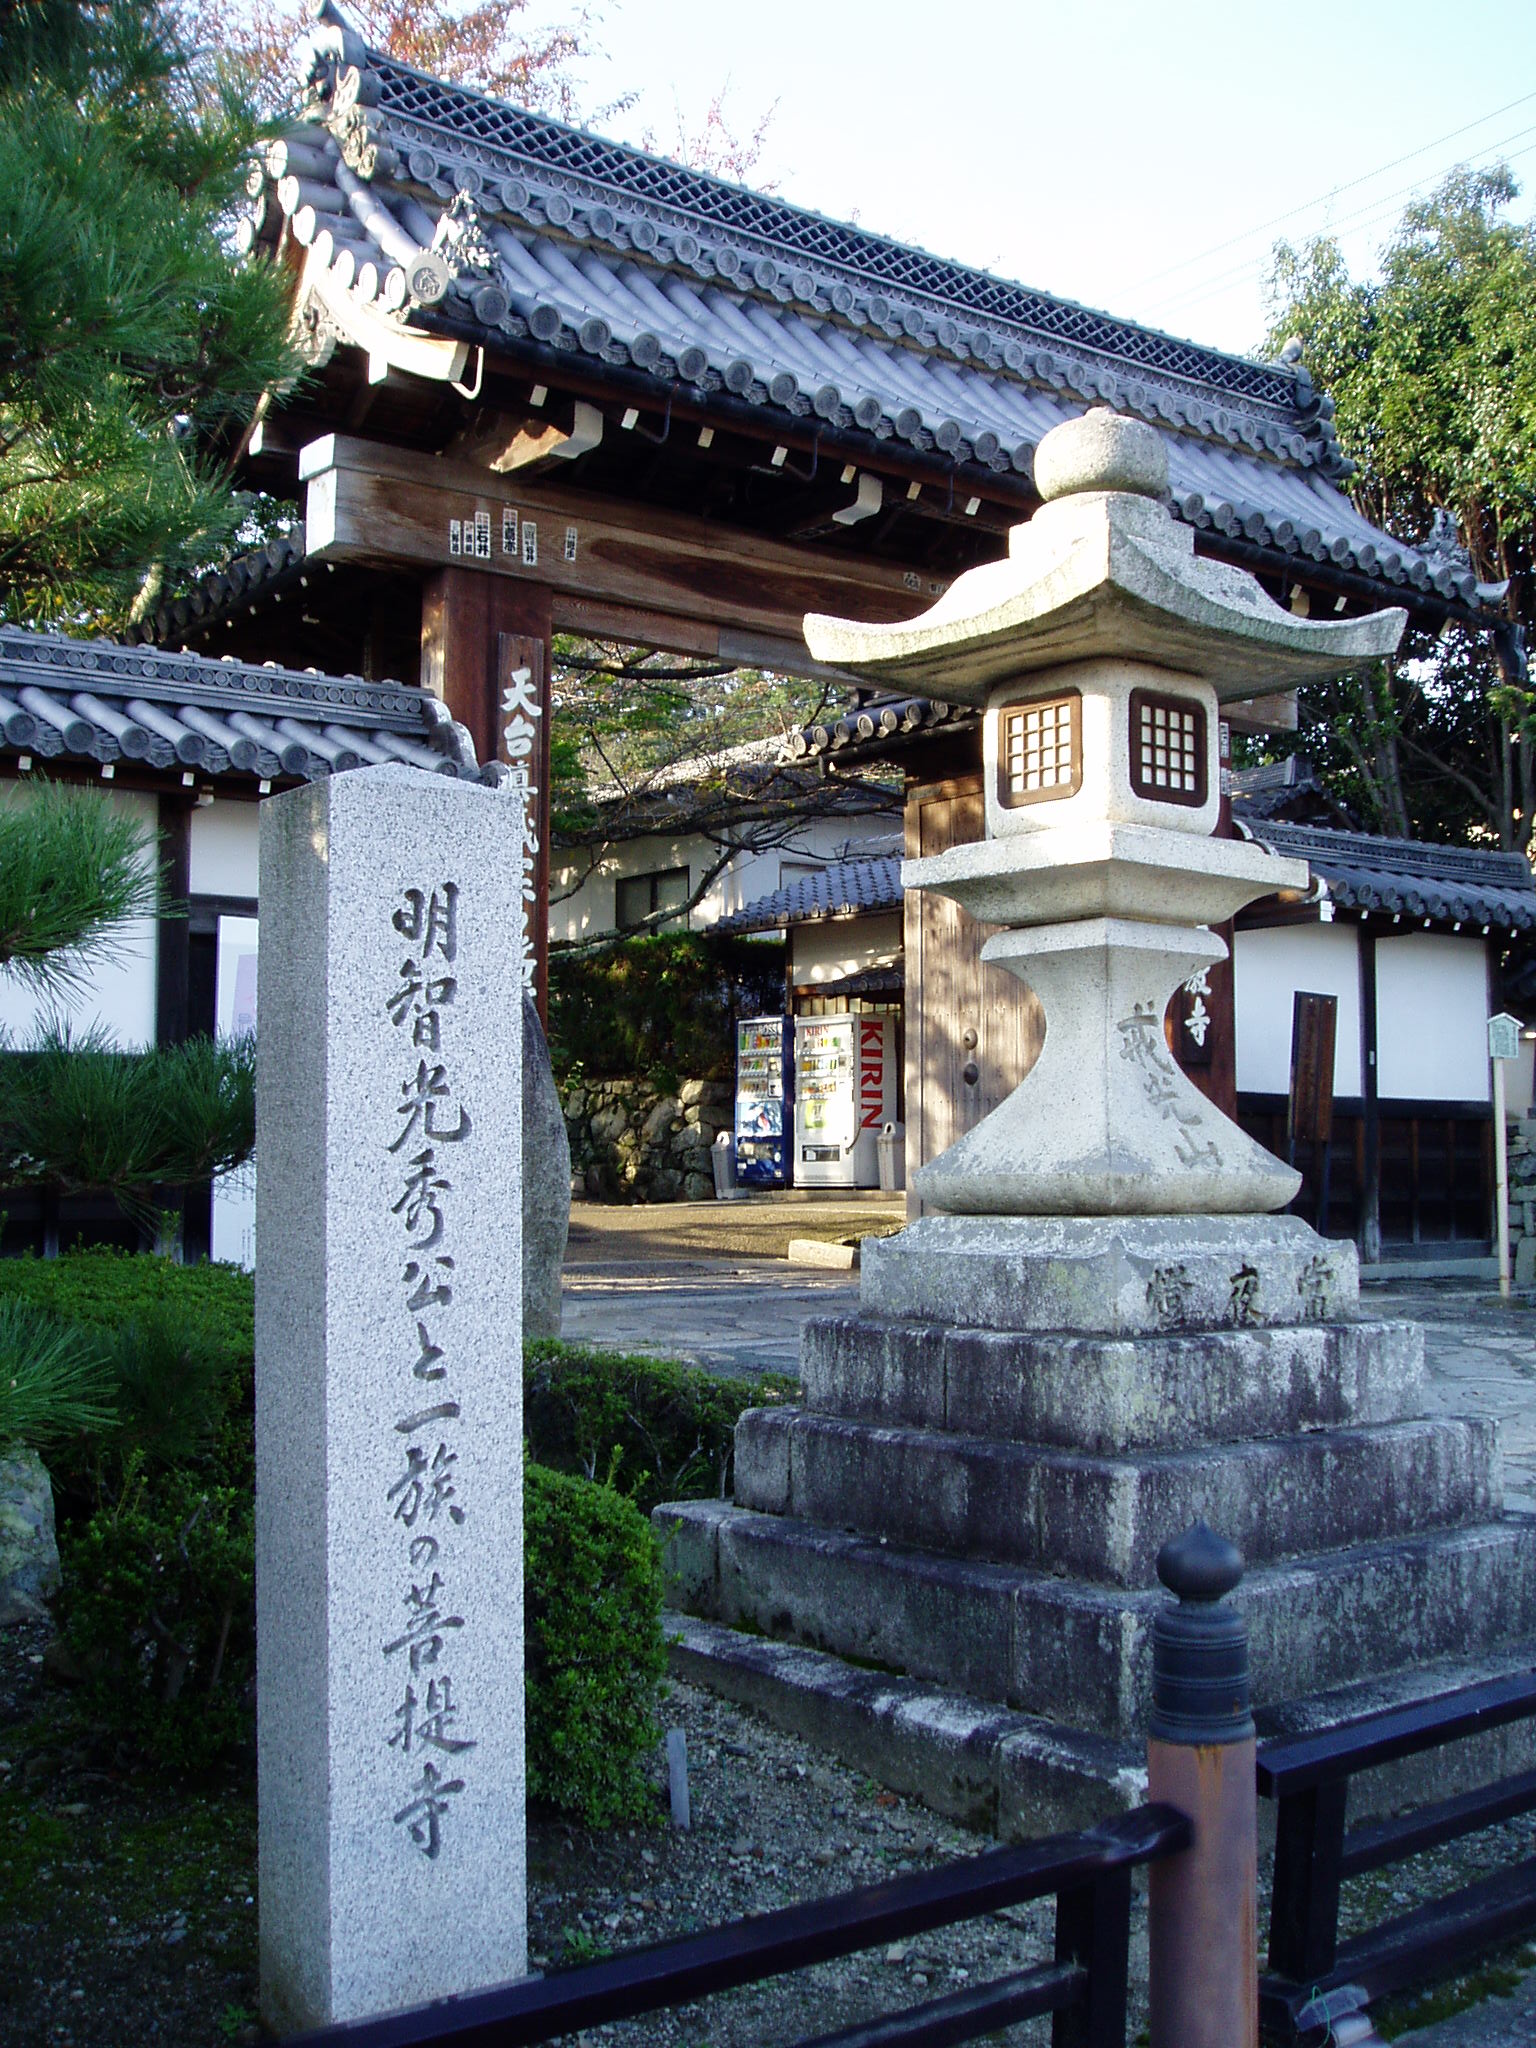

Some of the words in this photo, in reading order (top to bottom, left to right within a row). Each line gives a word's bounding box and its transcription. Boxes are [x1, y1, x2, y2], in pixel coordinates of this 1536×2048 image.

[860, 1020, 883, 1129] KIRIN
[382, 880, 477, 1860] 明智光秀公と一族の菩提寺
